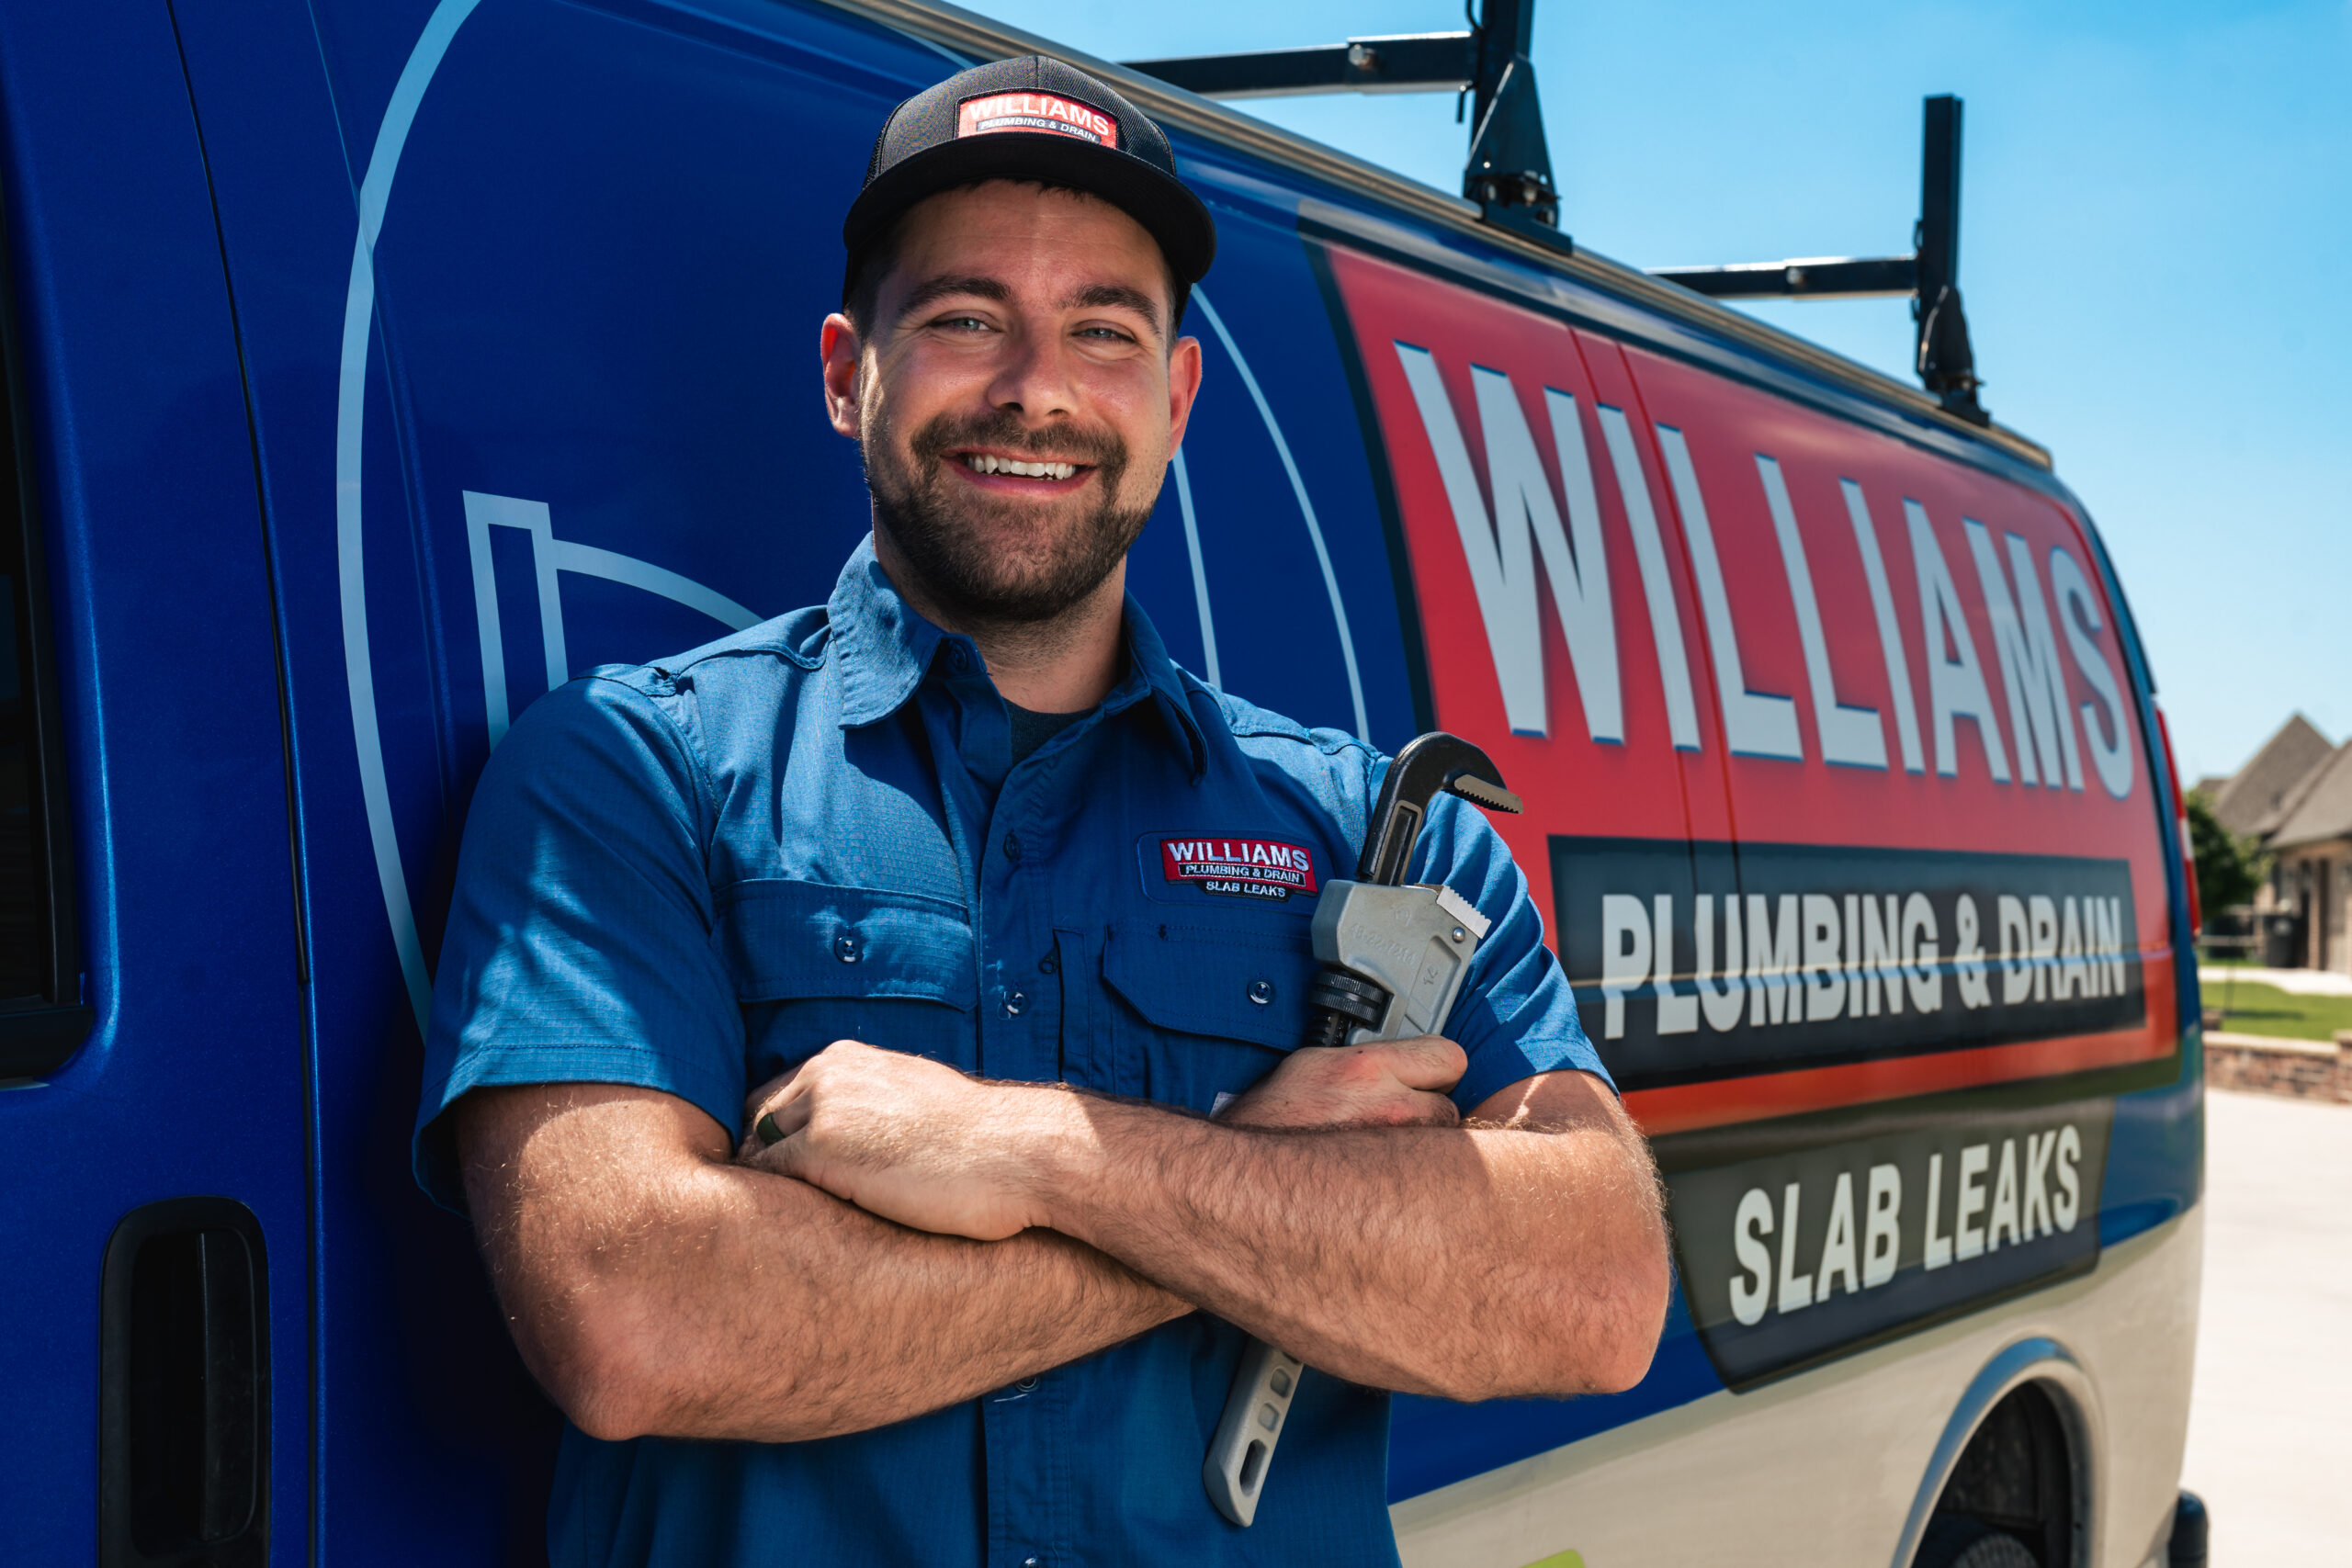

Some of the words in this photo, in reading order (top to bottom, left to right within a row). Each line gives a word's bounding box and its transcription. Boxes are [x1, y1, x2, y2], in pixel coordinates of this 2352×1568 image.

[968, 96, 1109, 136] WILLIAMS
[980, 117, 1046, 130] PLUMBING
[1048, 121, 1057, 130] &
[1060, 123, 1097, 142] DRAIN
[1393, 339, 2133, 800] WILLIAMS
[1167, 841, 1309, 872] WILLIAMS
[1185, 864, 1250, 877] PLUMBING
[1252, 868, 1261, 878] &
[1263, 869, 1300, 884] DRAIN
[1205, 880, 1240, 893] SLAB
[1243, 883, 1285, 897] LEAKS
[1601, 892, 1939, 1040] PLUMBING
[1955, 893, 1991, 1009] &
[1998, 895, 2126, 1006] DRAIN
[1729, 1163, 1902, 1326] SLAB
[1924, 1124, 2082, 1271] LEAKS
